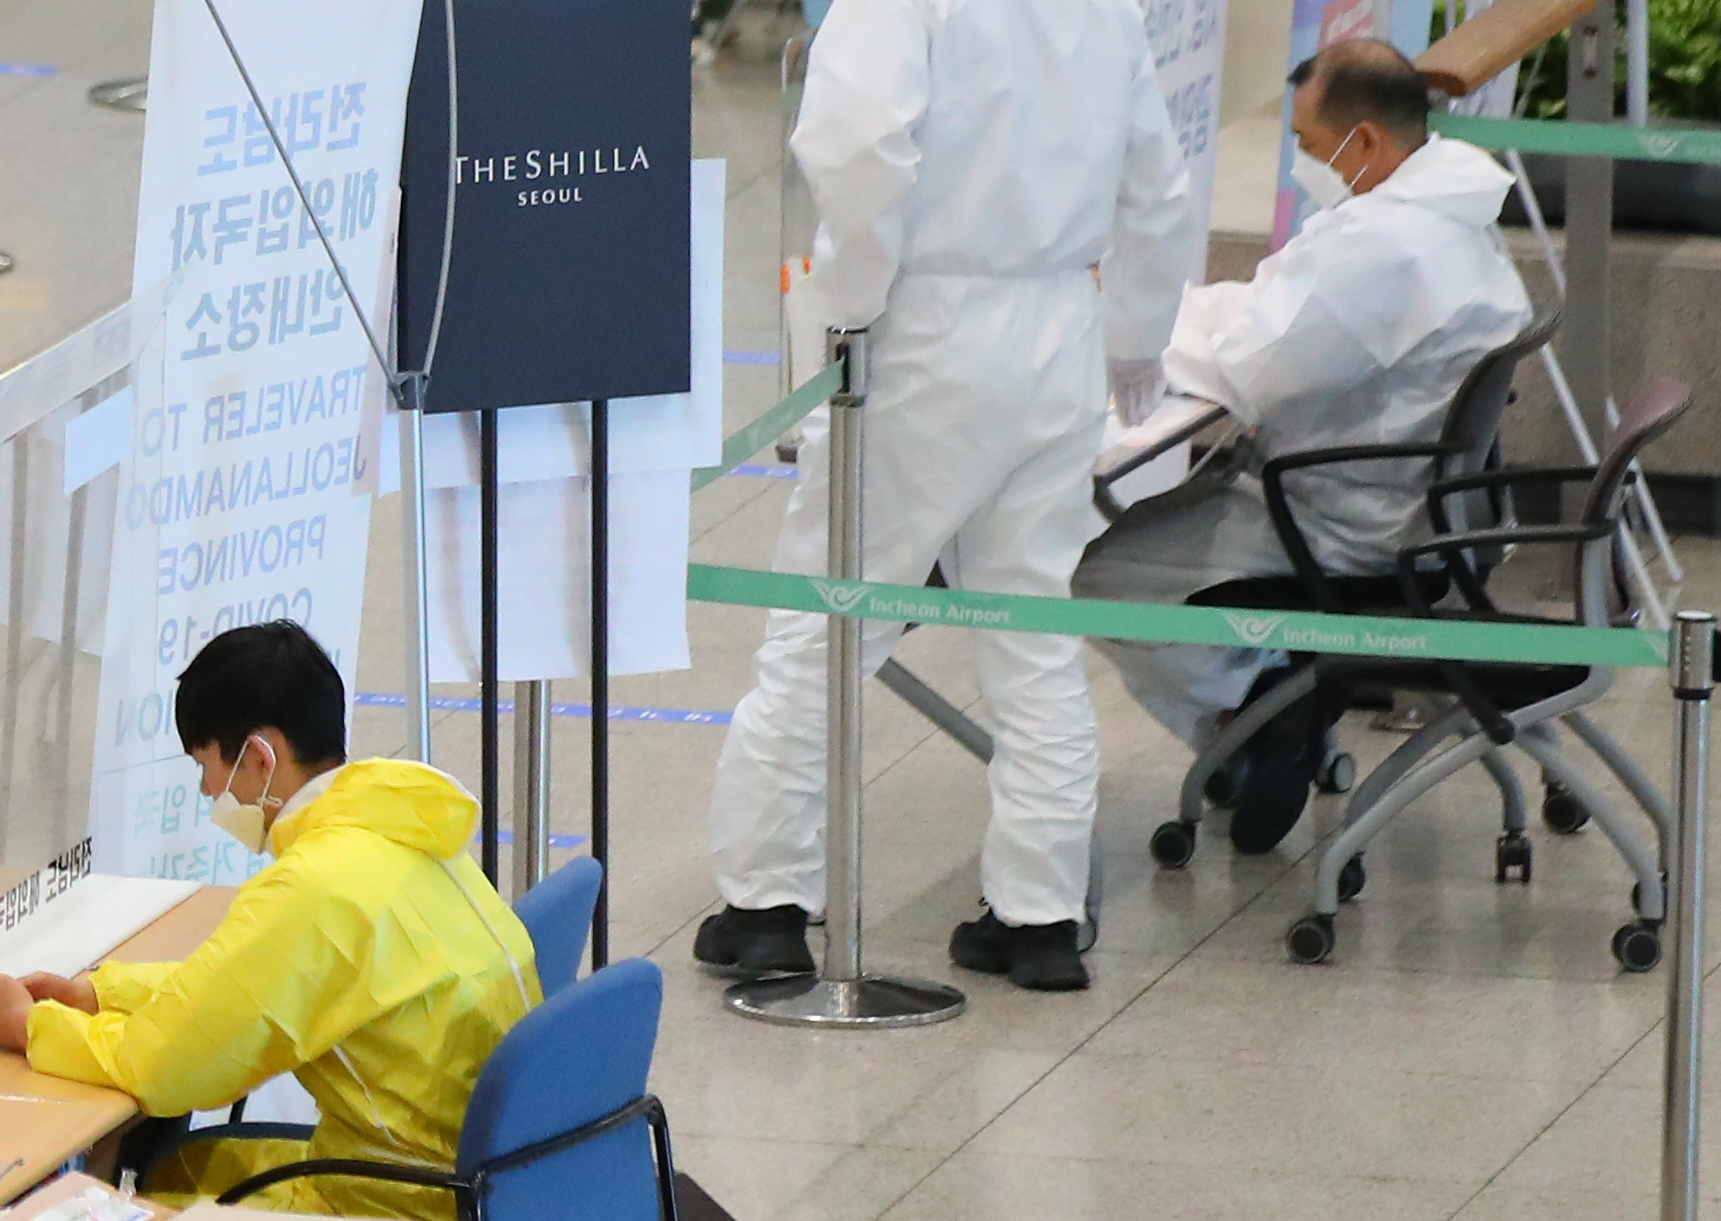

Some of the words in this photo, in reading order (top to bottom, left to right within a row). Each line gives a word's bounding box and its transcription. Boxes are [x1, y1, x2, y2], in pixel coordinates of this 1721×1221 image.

[517, 187, 583, 207] SEOUL
[870, 597, 941, 619] Incheon
[946, 603, 1010, 625] Airport
[1283, 628, 1356, 647] Incheon
[1361, 632, 1427, 654] Airport
